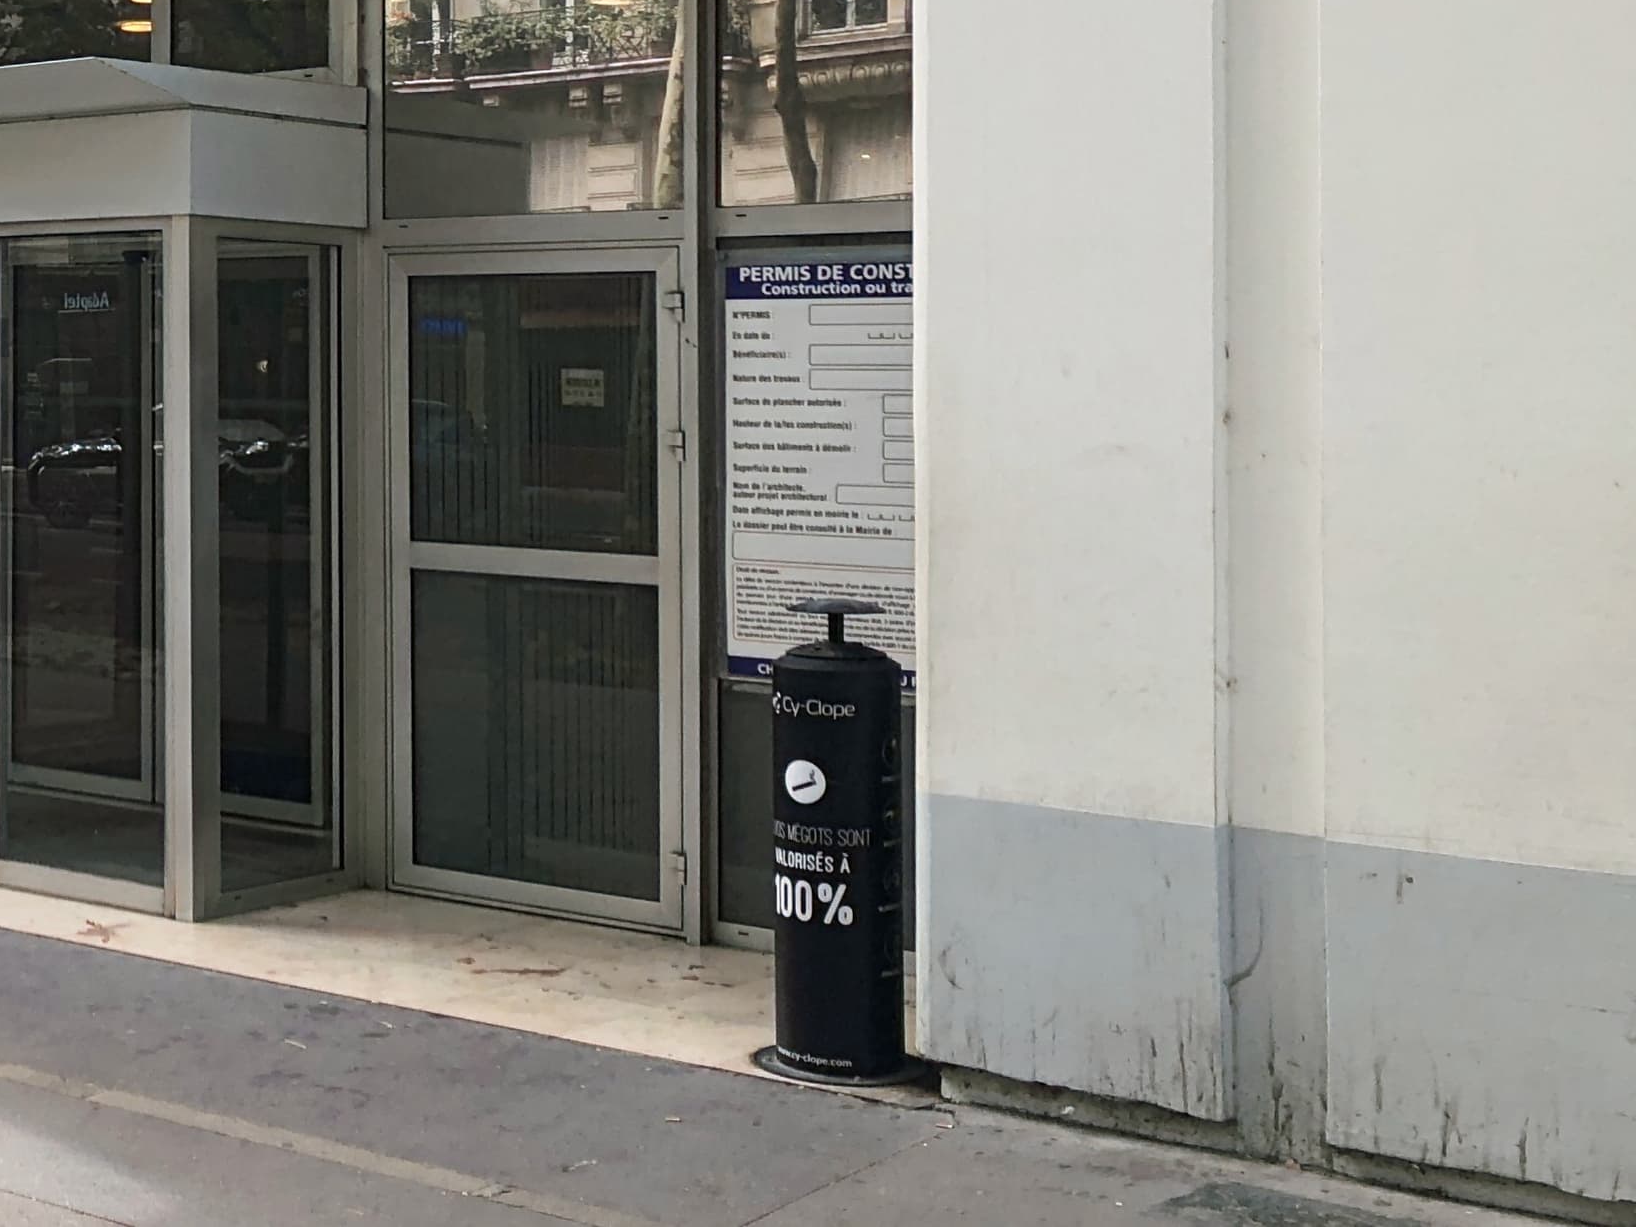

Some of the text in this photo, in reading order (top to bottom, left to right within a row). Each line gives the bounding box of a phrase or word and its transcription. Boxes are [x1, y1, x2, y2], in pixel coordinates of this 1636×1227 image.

[739, 266, 811, 282] PERMIS
[817, 264, 844, 281] DE
[761, 281, 861, 295] Construction
[865, 282, 886, 294] ou
[782, 695, 856, 721] Cy-Clope
[787, 822, 833, 846] MÉGOTS
[836, 828, 871, 847] SONT
[839, 852, 851, 874] À
